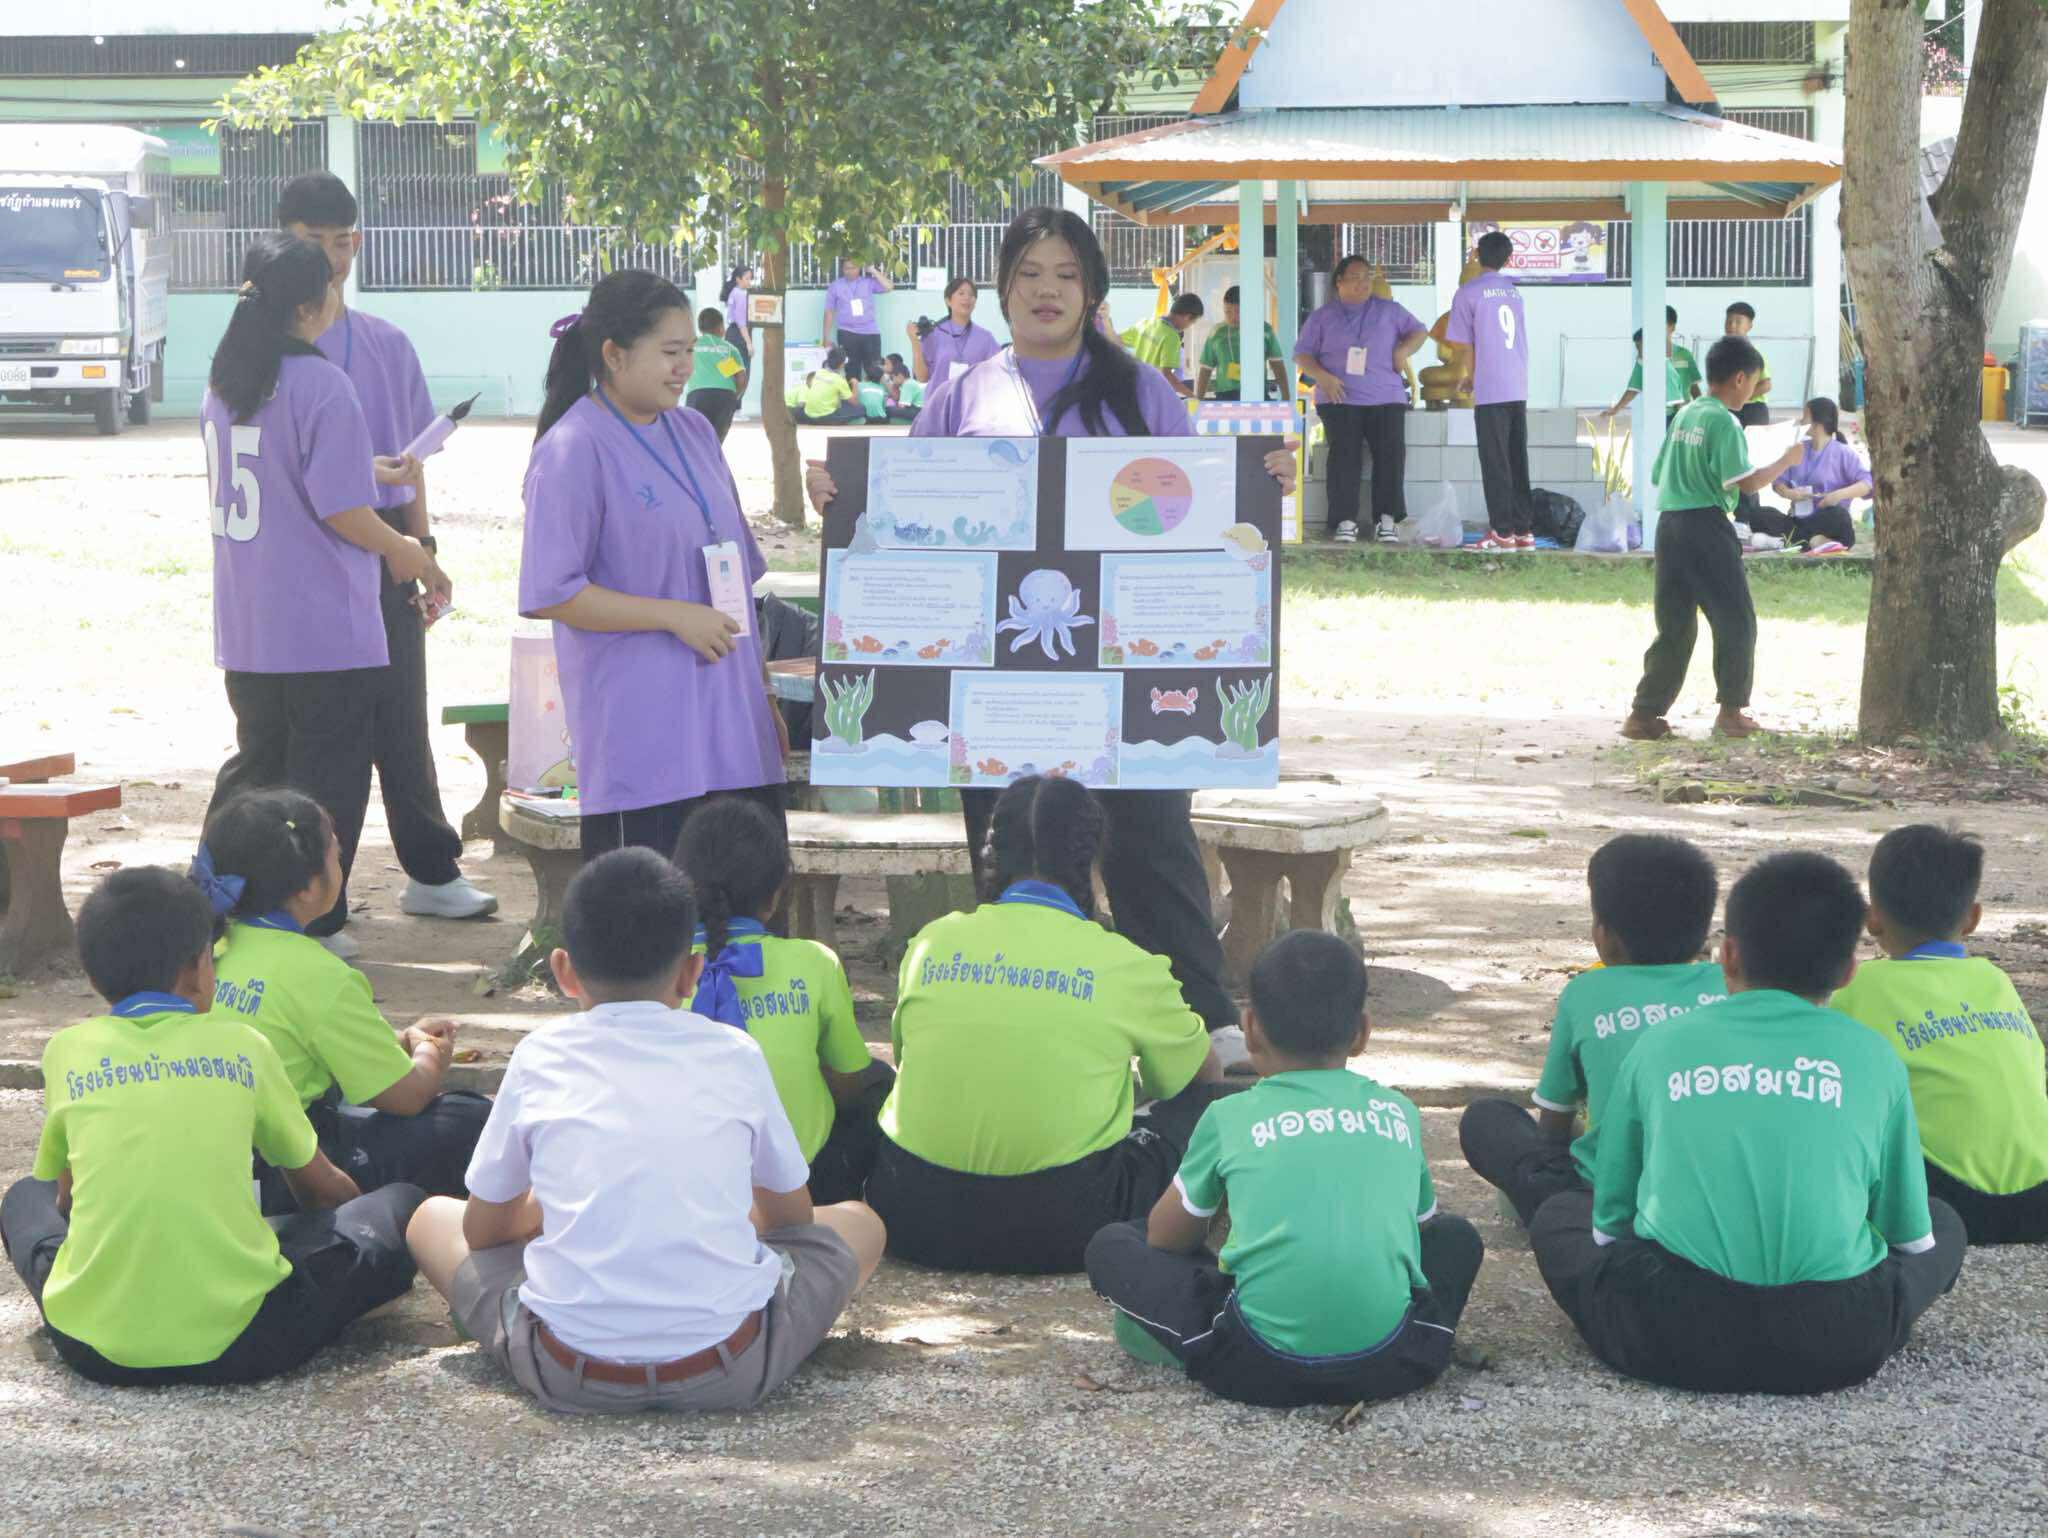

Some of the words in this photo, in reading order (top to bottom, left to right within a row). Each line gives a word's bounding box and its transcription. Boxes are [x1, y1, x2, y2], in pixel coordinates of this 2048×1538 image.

[1498, 304, 1516, 350] 9
[920, 952, 1095, 1003] โรงเรียนบ้านมอสมบัติ
[65, 1053, 256, 1102] โรงเรียนบ้านมอสมบัติ
[1668, 1056, 1843, 1108] มอสมบัติ
[1251, 1099, 1413, 1150] มอสมบัติ
